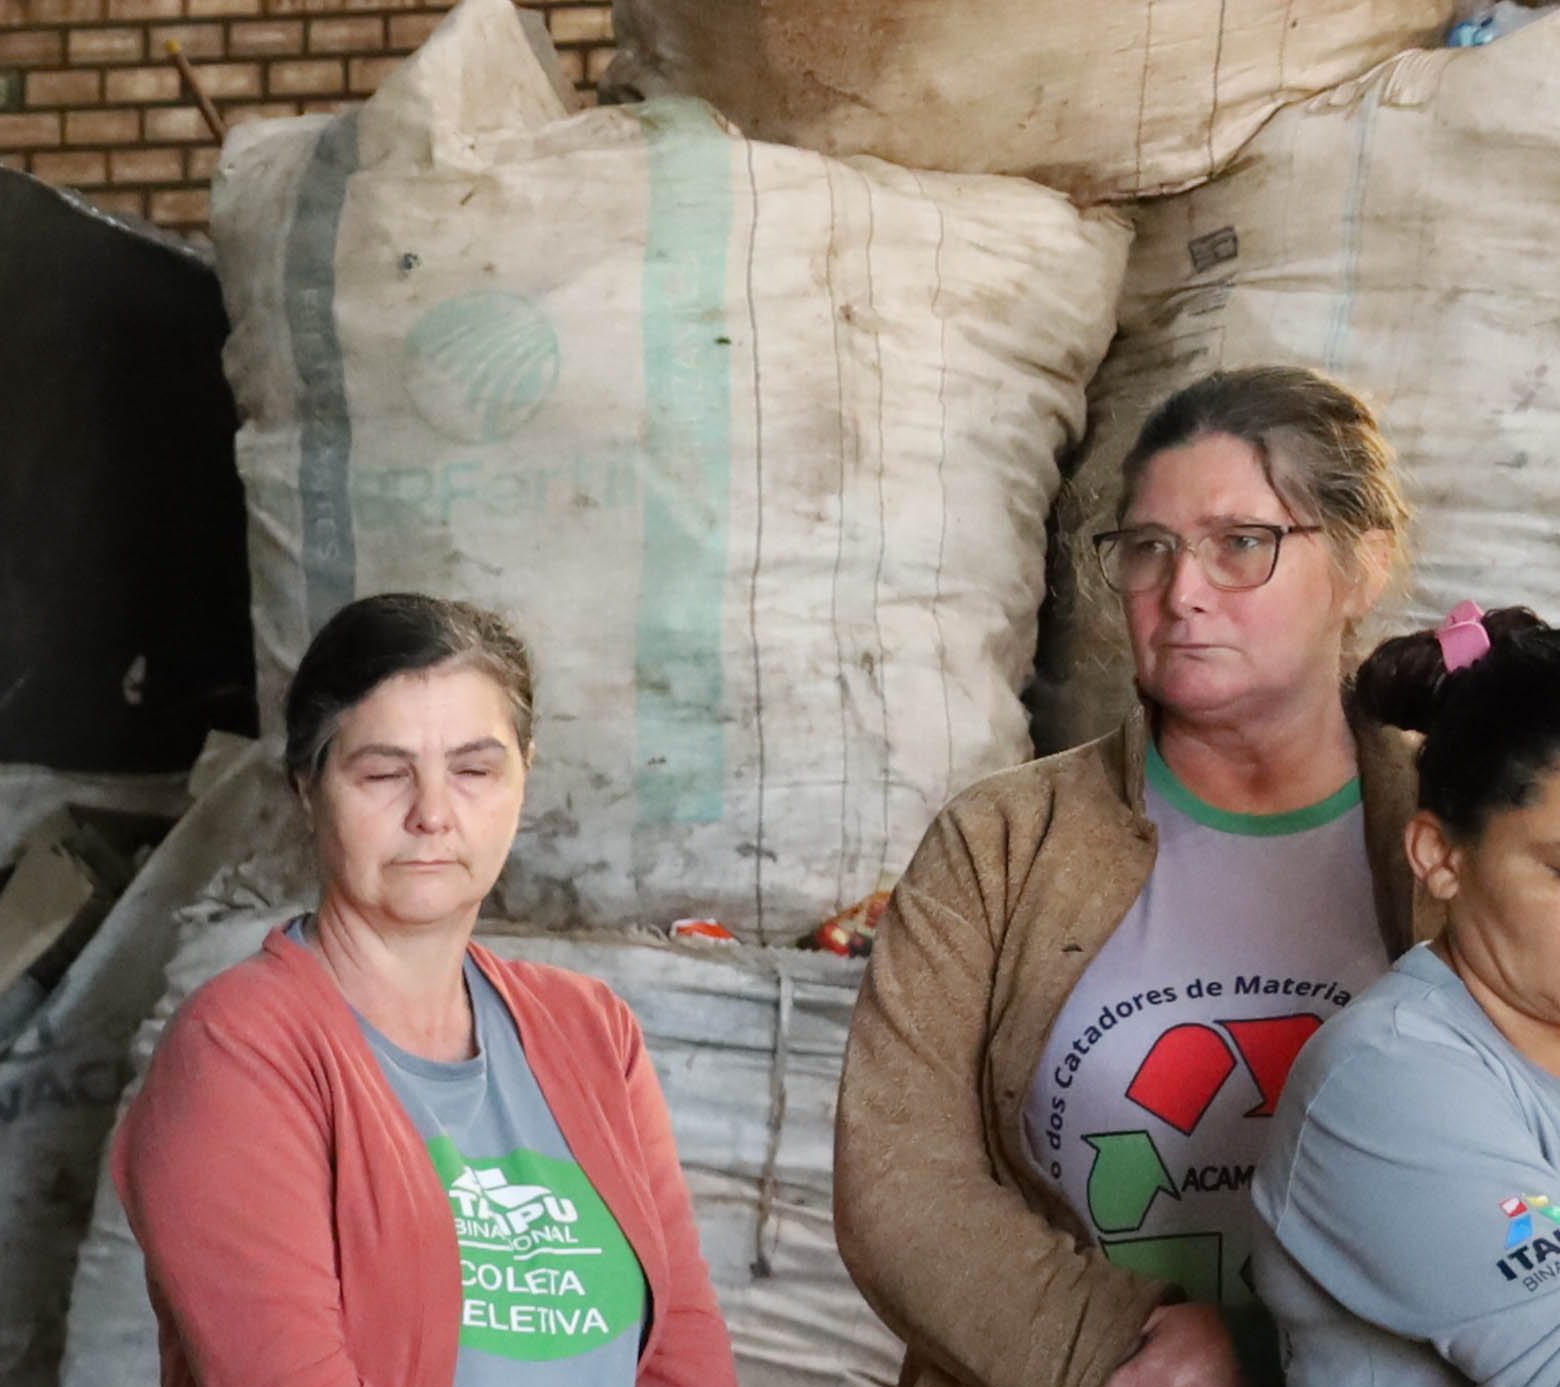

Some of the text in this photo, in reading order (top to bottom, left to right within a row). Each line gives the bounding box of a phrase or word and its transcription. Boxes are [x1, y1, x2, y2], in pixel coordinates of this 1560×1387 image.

[1186, 978, 1223, 998] de
[1234, 974, 1353, 1007] Materia
[1054, 984, 1178, 1089] Catadores
[1045, 1096, 1066, 1151] dos
[1181, 1164, 1255, 1193] ACAM
[1496, 1228, 1560, 1282] ITA
[462, 1297, 610, 1336] ELETIVA
